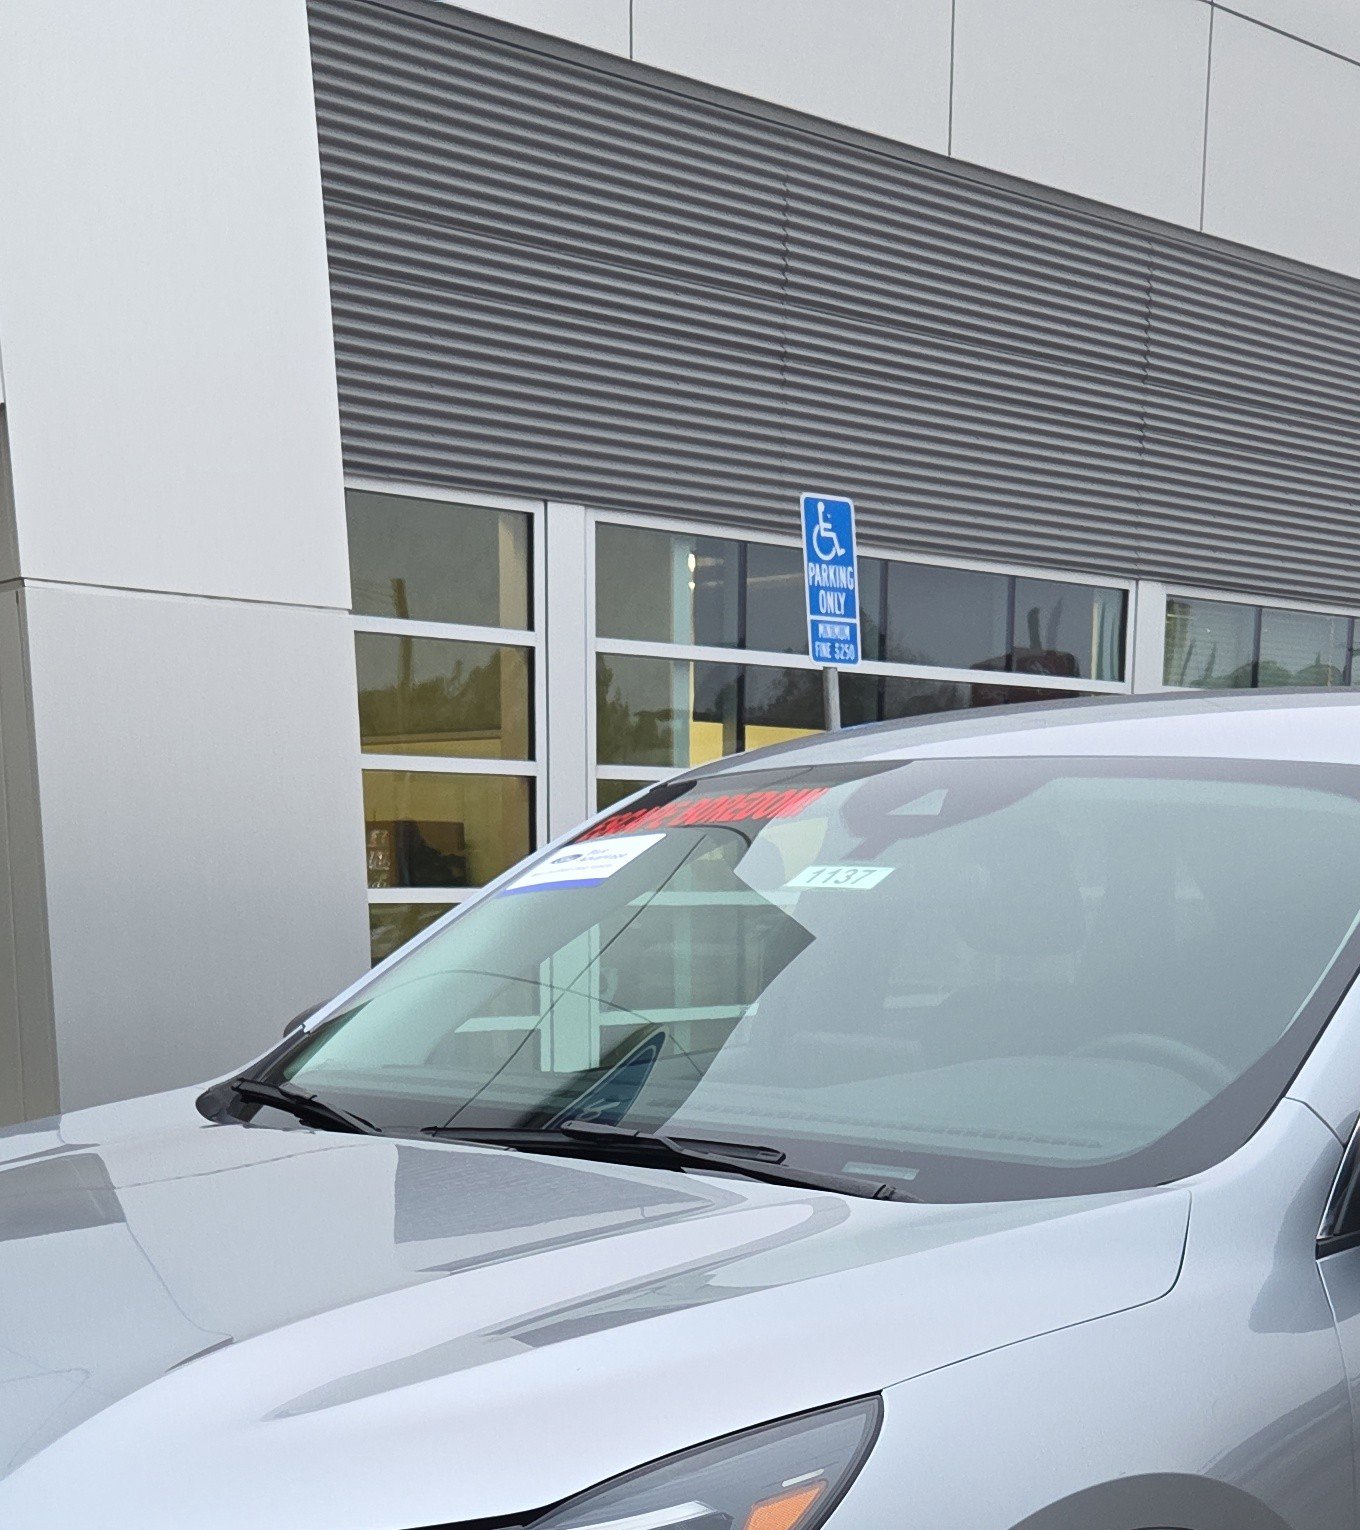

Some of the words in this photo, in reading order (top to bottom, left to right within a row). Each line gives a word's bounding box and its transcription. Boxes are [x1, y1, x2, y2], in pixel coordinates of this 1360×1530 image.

[808, 562, 855, 590] PARKING
[818, 590, 846, 615] ONLY
[815, 641, 832, 658] FINE
[805, 867, 878, 885] 1137
